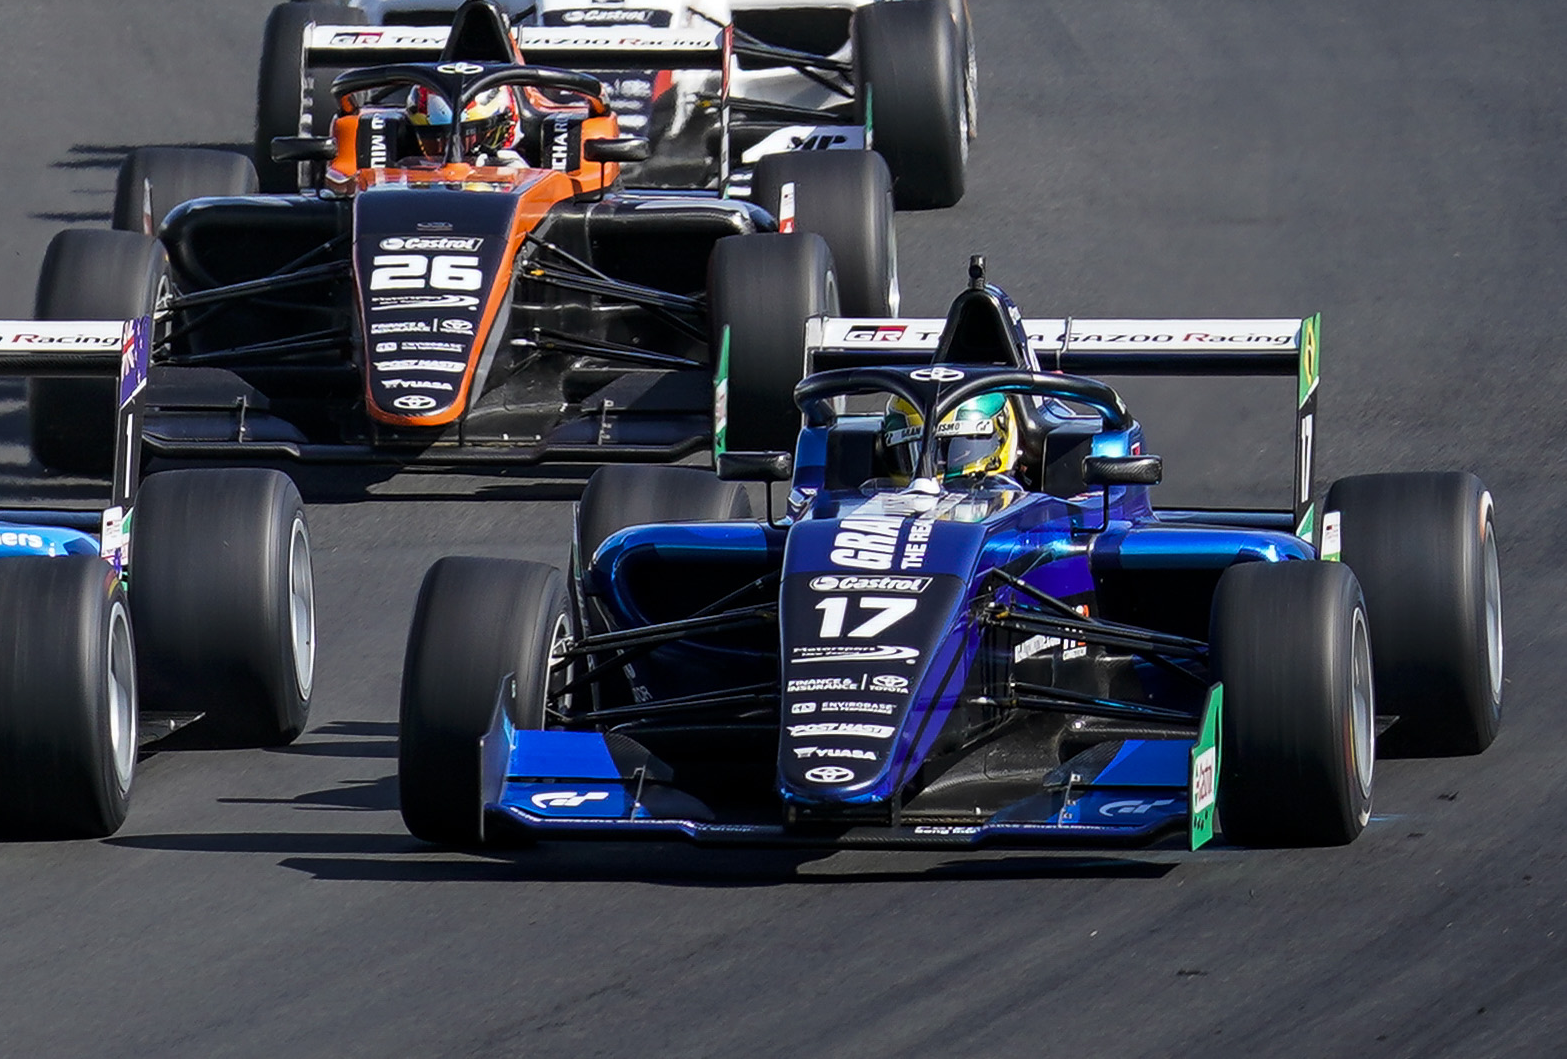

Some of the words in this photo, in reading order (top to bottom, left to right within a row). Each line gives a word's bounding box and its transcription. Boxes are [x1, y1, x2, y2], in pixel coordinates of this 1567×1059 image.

[392, 36, 446, 45] TOY
[618, 37, 713, 48] Racing
[404, 238, 475, 250] Castrol
[370, 254, 483, 291] 26
[12, 333, 122, 347] Racing
[843, 325, 909, 342] GR
[1056, 332, 1175, 343] GAZOO
[1182, 331, 1293, 346] Racing
[901, 543, 928, 570] THE
[838, 576, 922, 591] Castrol
[814, 596, 918, 639] 17
[787, 684, 858, 693] INSURANCE
[788, 678, 841, 686] FINANCE
[869, 686, 909, 694] TOYOTA
[816, 749, 877, 760] YUASA
